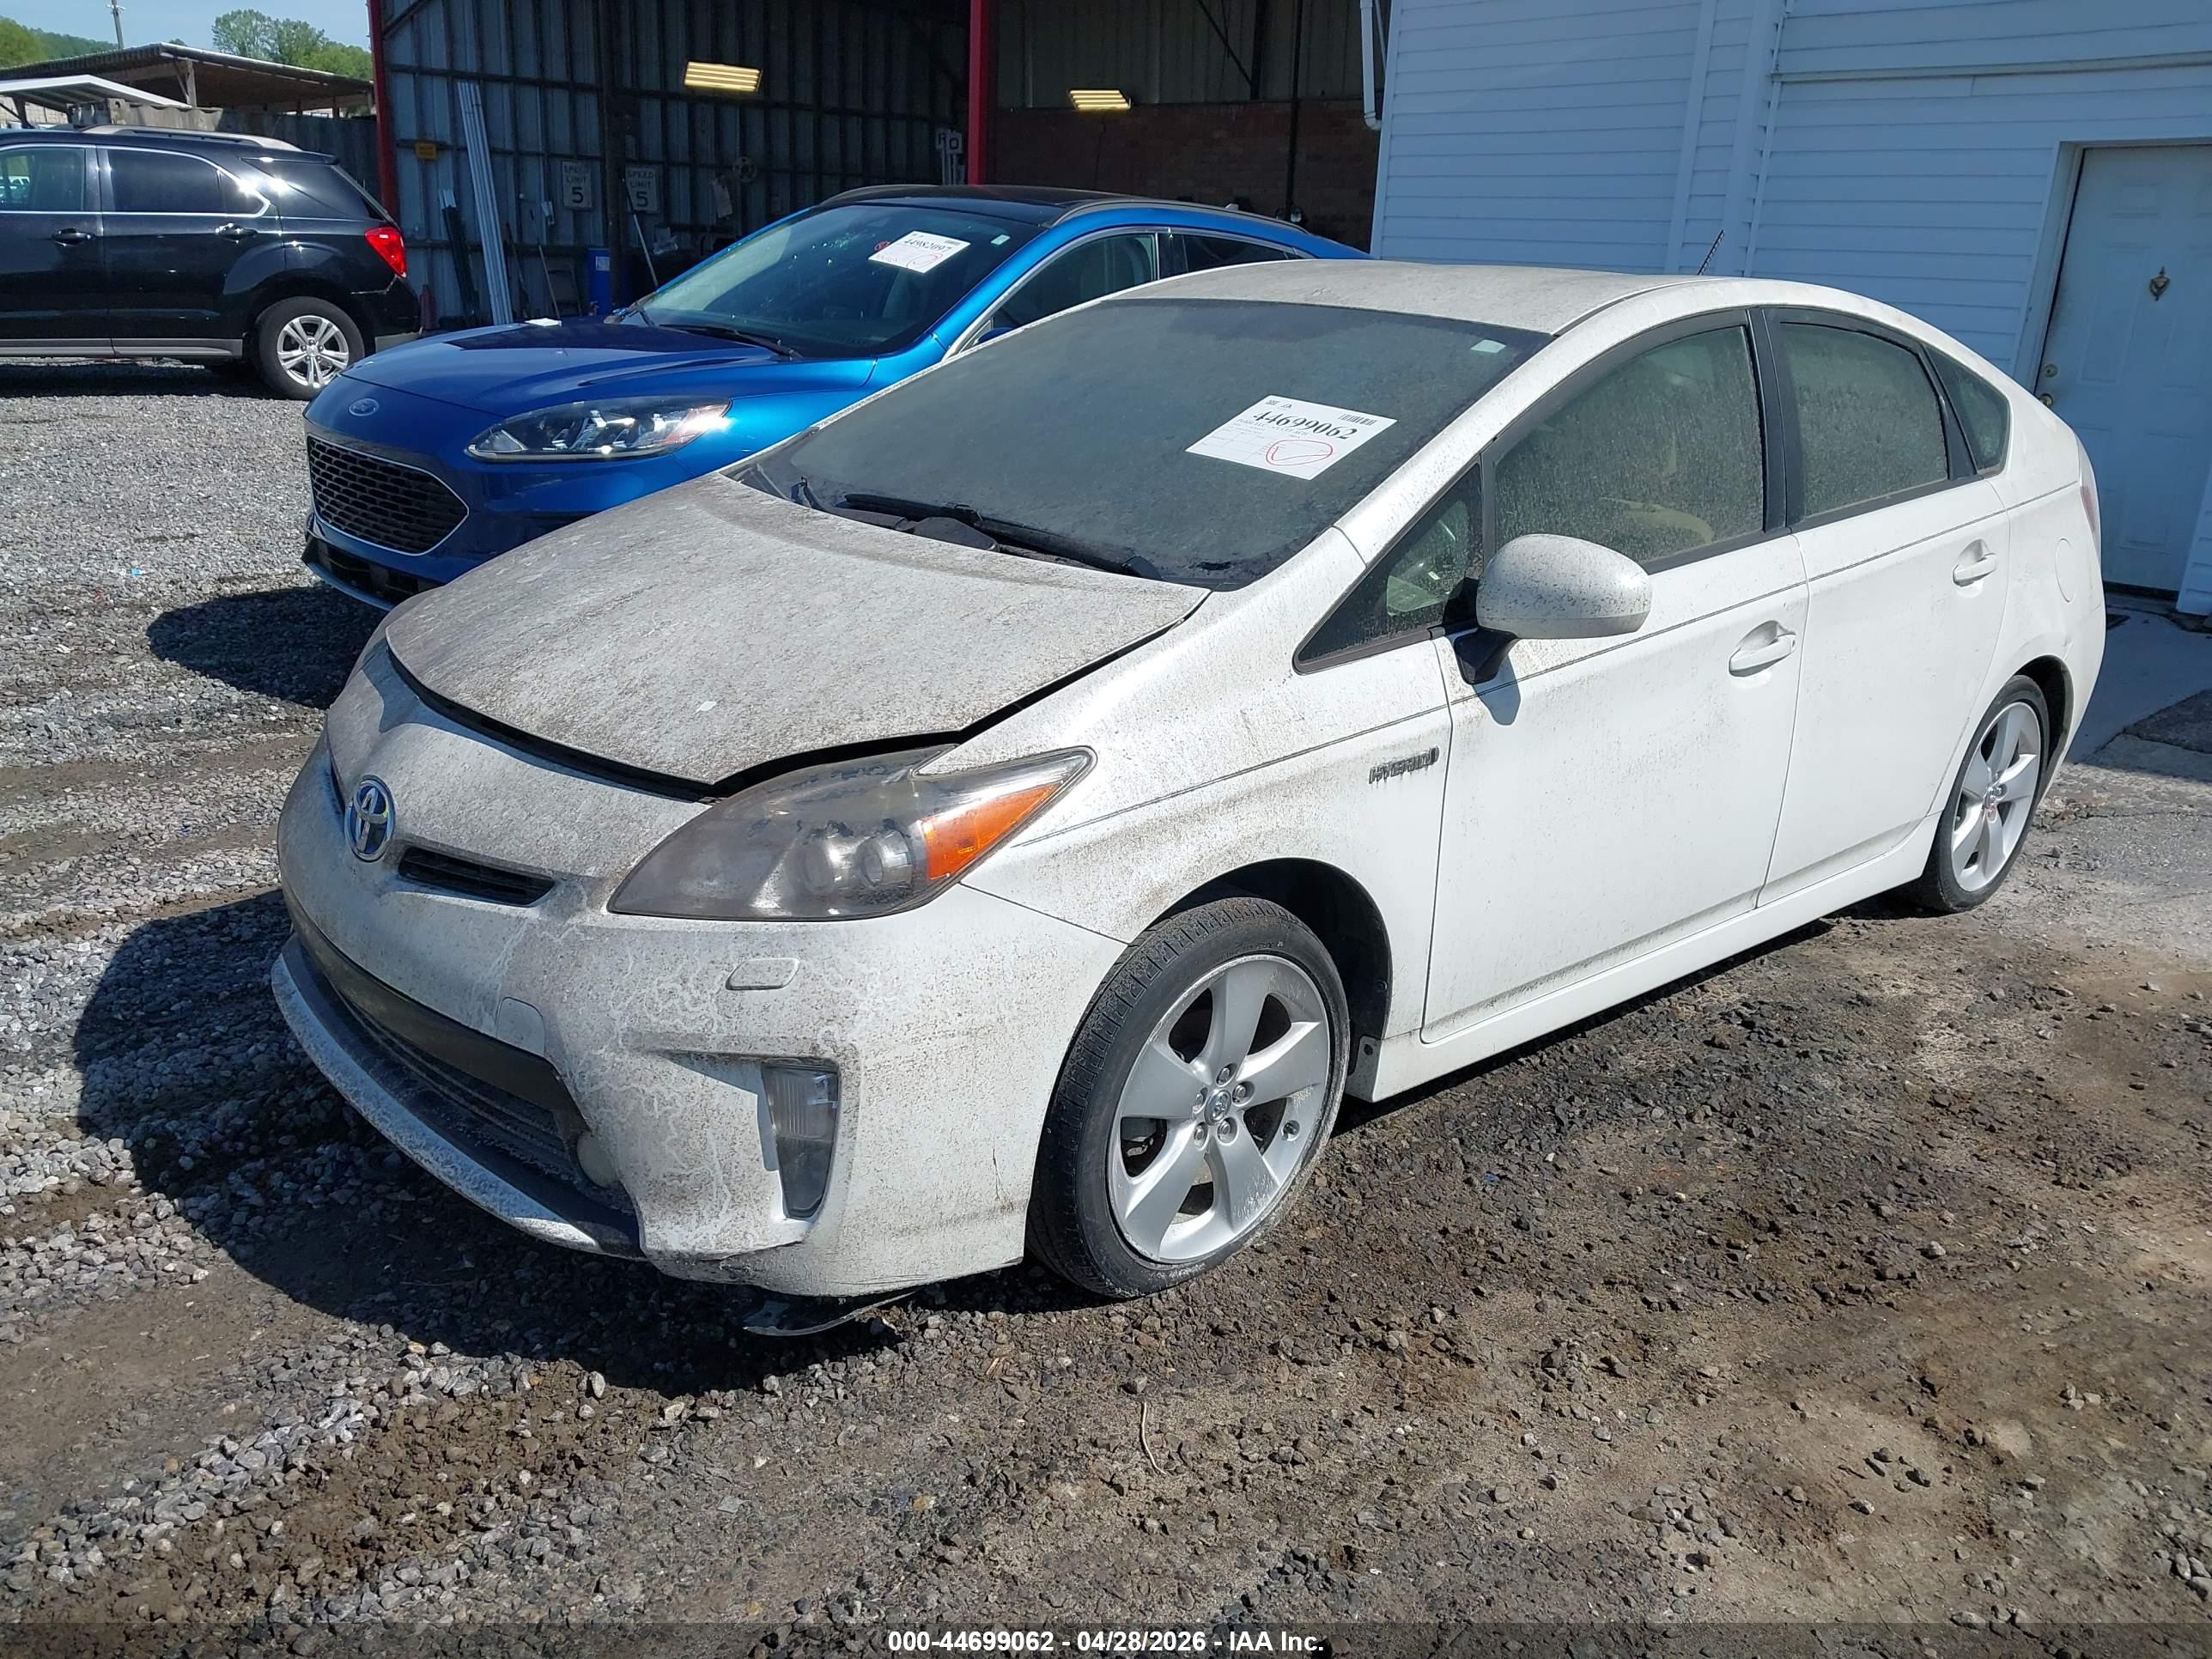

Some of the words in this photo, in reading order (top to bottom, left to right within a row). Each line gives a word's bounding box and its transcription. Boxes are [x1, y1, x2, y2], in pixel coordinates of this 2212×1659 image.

[572, 186, 584, 204] 5
[636, 191, 649, 207] 5
[1253, 411, 1358, 440] 44699062
